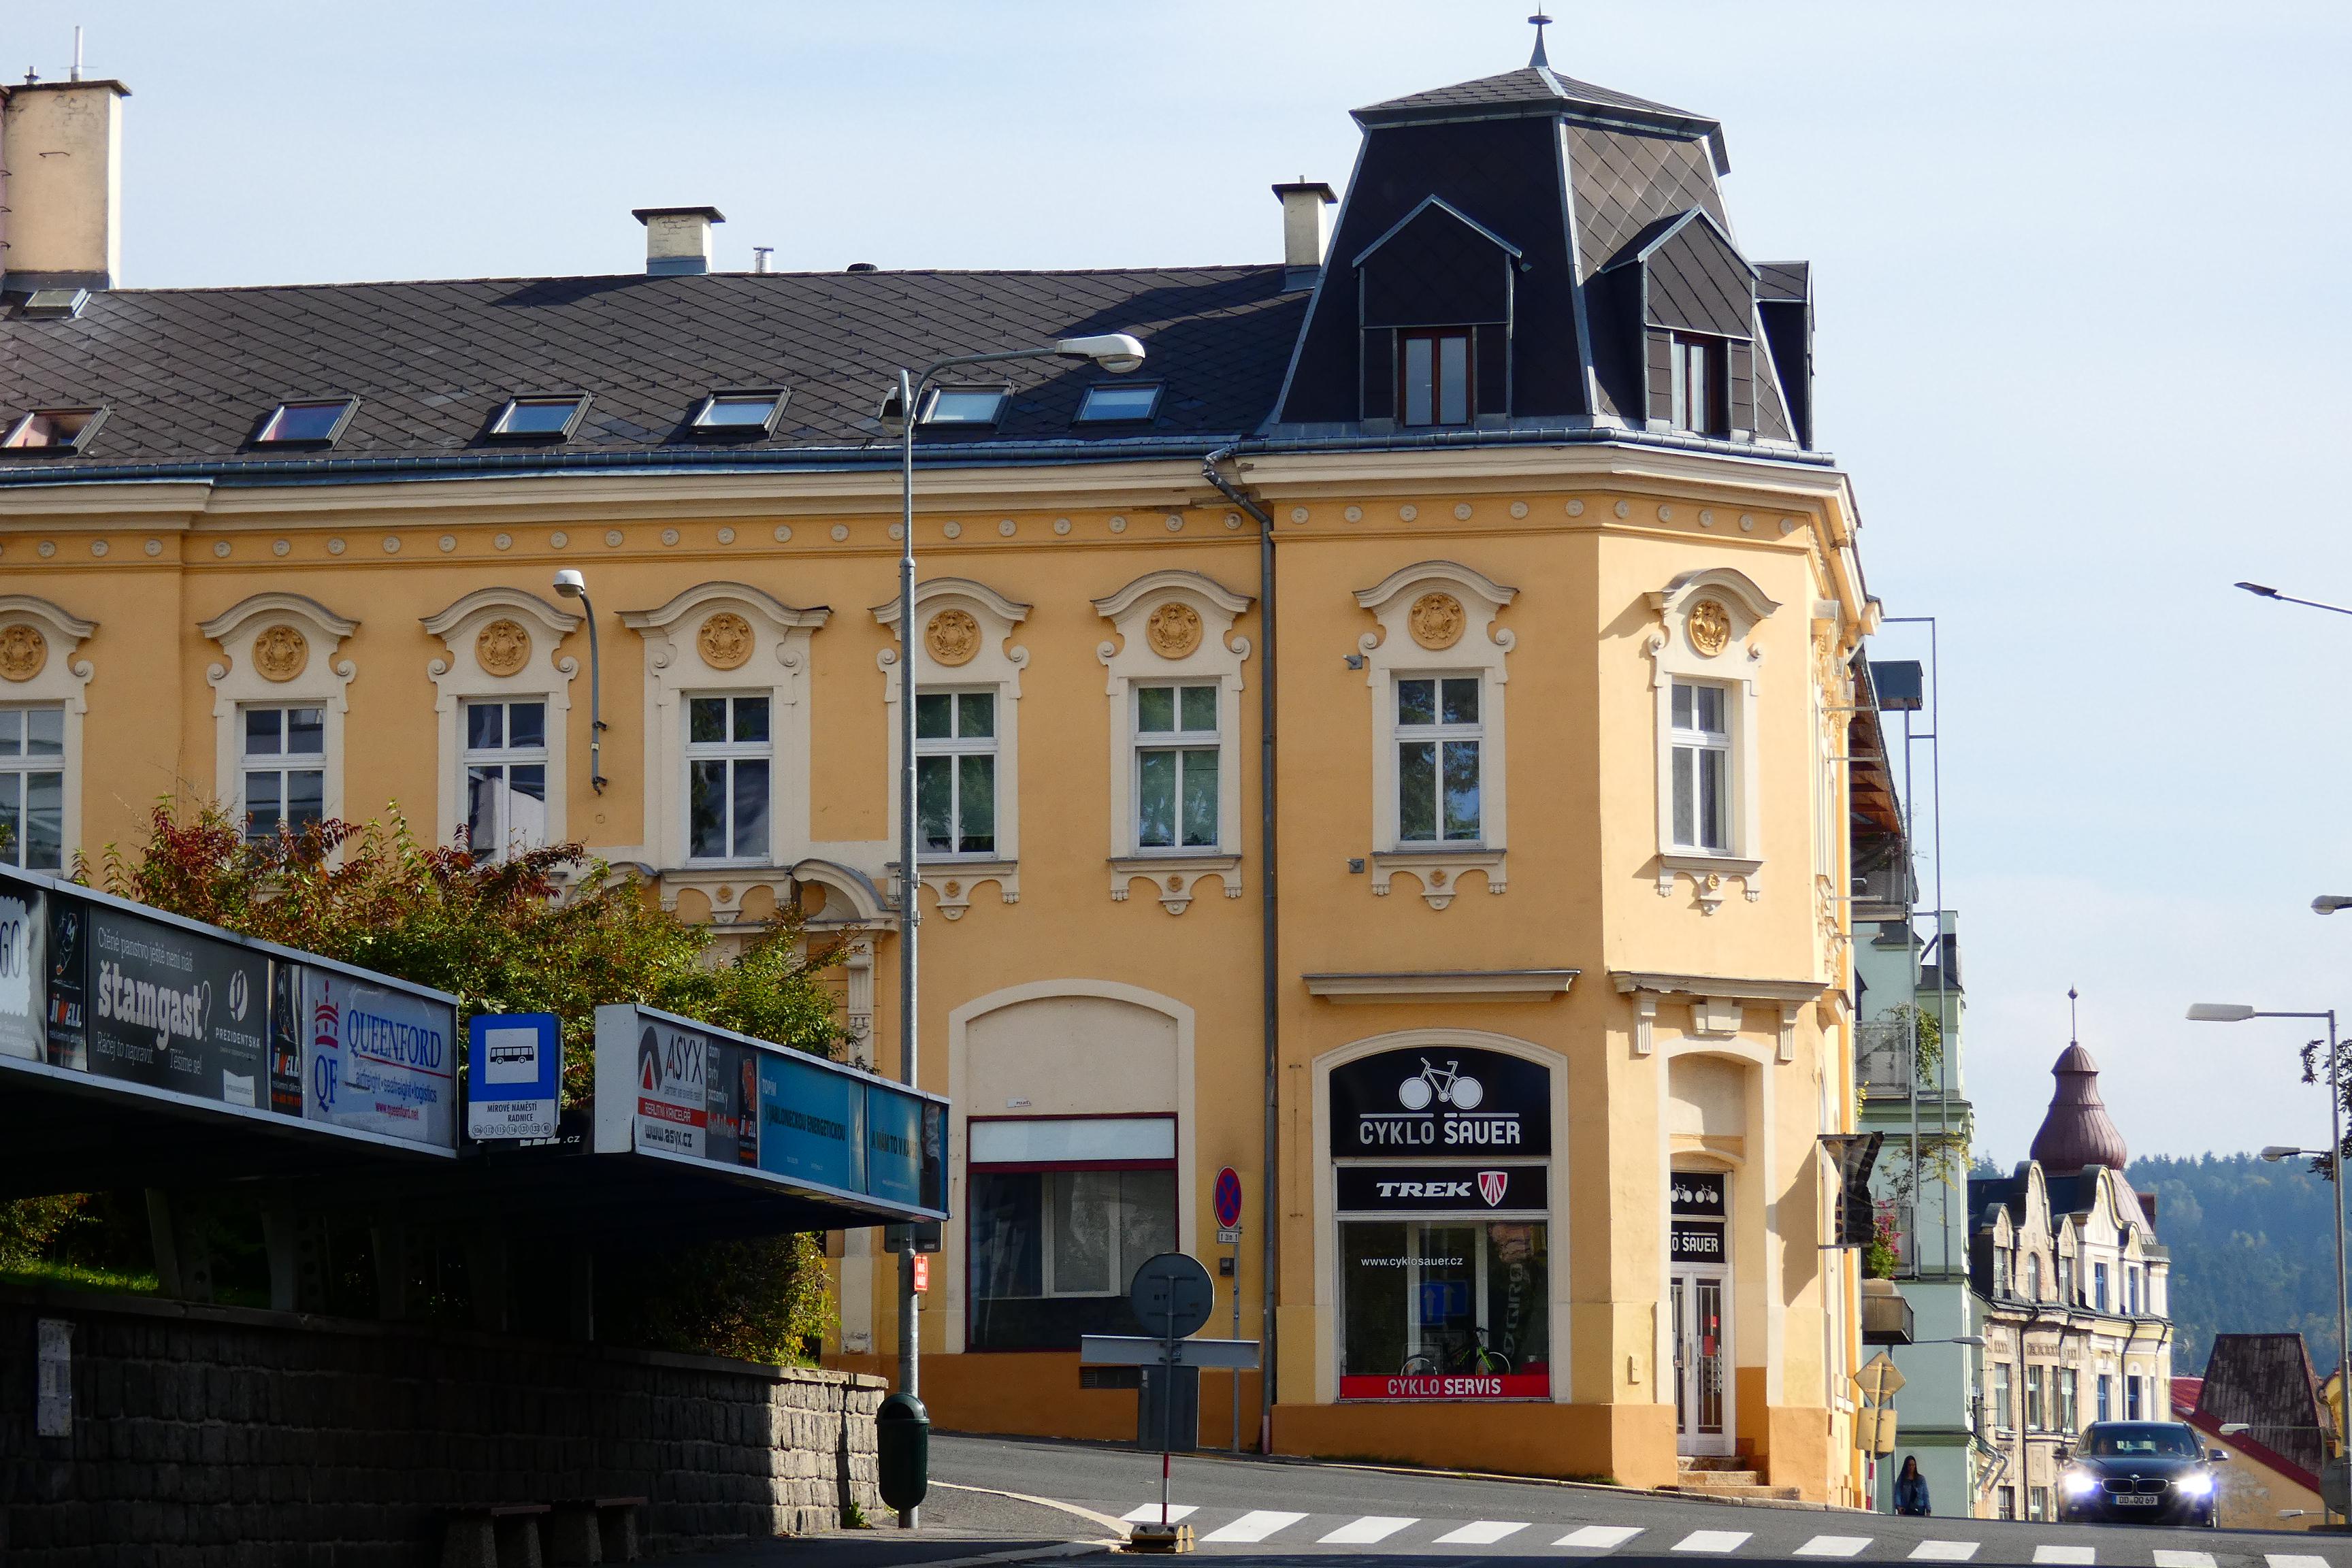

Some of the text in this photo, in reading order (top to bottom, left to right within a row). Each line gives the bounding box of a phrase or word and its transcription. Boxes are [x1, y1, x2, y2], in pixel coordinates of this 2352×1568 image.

[98, 927, 193, 973] Ctěné panstvo ještě není náš
[98, 960, 211, 1051] štamgast?
[97, 1031, 116, 1061] Ráčej
[117, 1039, 124, 1057] to
[348, 1009, 442, 1068] QUEENFORD
[170, 1049, 193, 1072] Těšíme
[665, 1034, 702, 1085] ASYX
[315, 1055, 338, 1113] QF
[487, 1100, 538, 1113] MÍROVÉ NÁMĚSTÍ
[508, 1113, 534, 1122] RADNICE
[644, 1124, 692, 1150] www.asyx.cz
[1360, 1121, 1520, 1145] CYKLO SAUER
[1375, 1181, 1473, 1198] TREK
[1682, 1237, 1718, 1253] SAUER
[1361, 1256, 1463, 1269] www.cyklosauer.cz
[1388, 1378, 1501, 1395] CYKLO SERVIS
